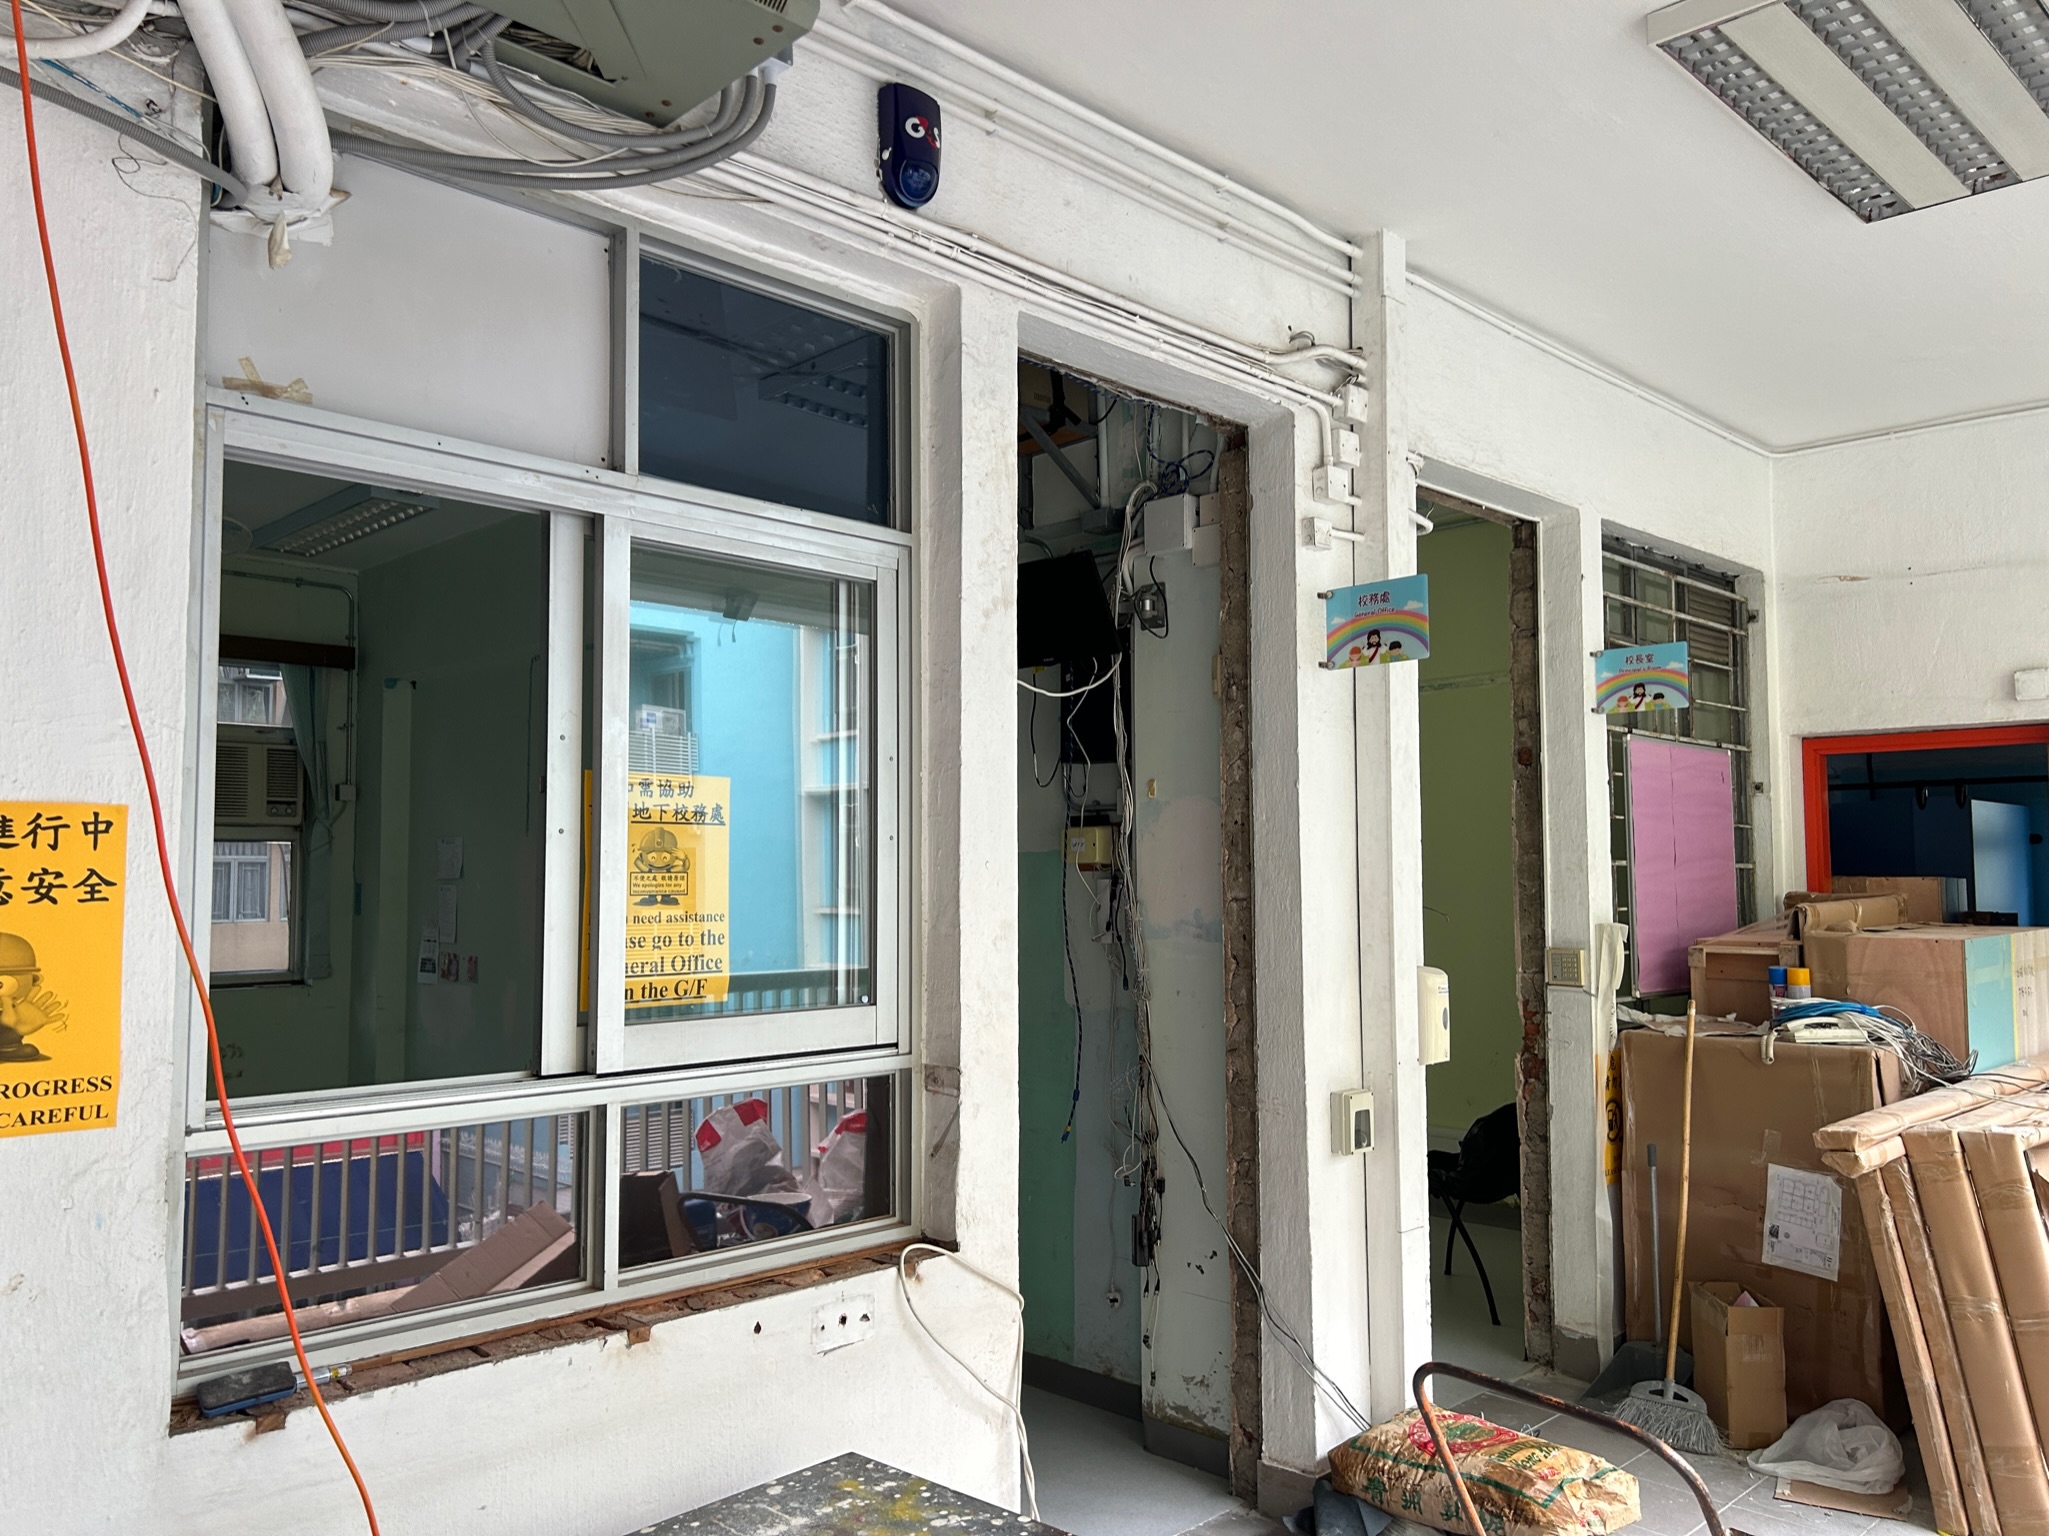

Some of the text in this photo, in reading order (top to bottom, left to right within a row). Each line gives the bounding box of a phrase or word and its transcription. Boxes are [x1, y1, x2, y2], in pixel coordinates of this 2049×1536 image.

[1358, 591, 1390, 607] 校務處
[1377, 606, 1395, 614] Office
[1625, 653, 1654, 665] 校長室
[628, 801, 725, 823] 地下校務處
[633, 911, 661, 924] need
[666, 911, 725, 923] assistance
[626, 929, 725, 951] se go to the
[671, 954, 722, 972] Office
[641, 982, 668, 999] the
[673, 978, 707, 997] G/F
[0, 1104, 109, 1128] CAREFUL
